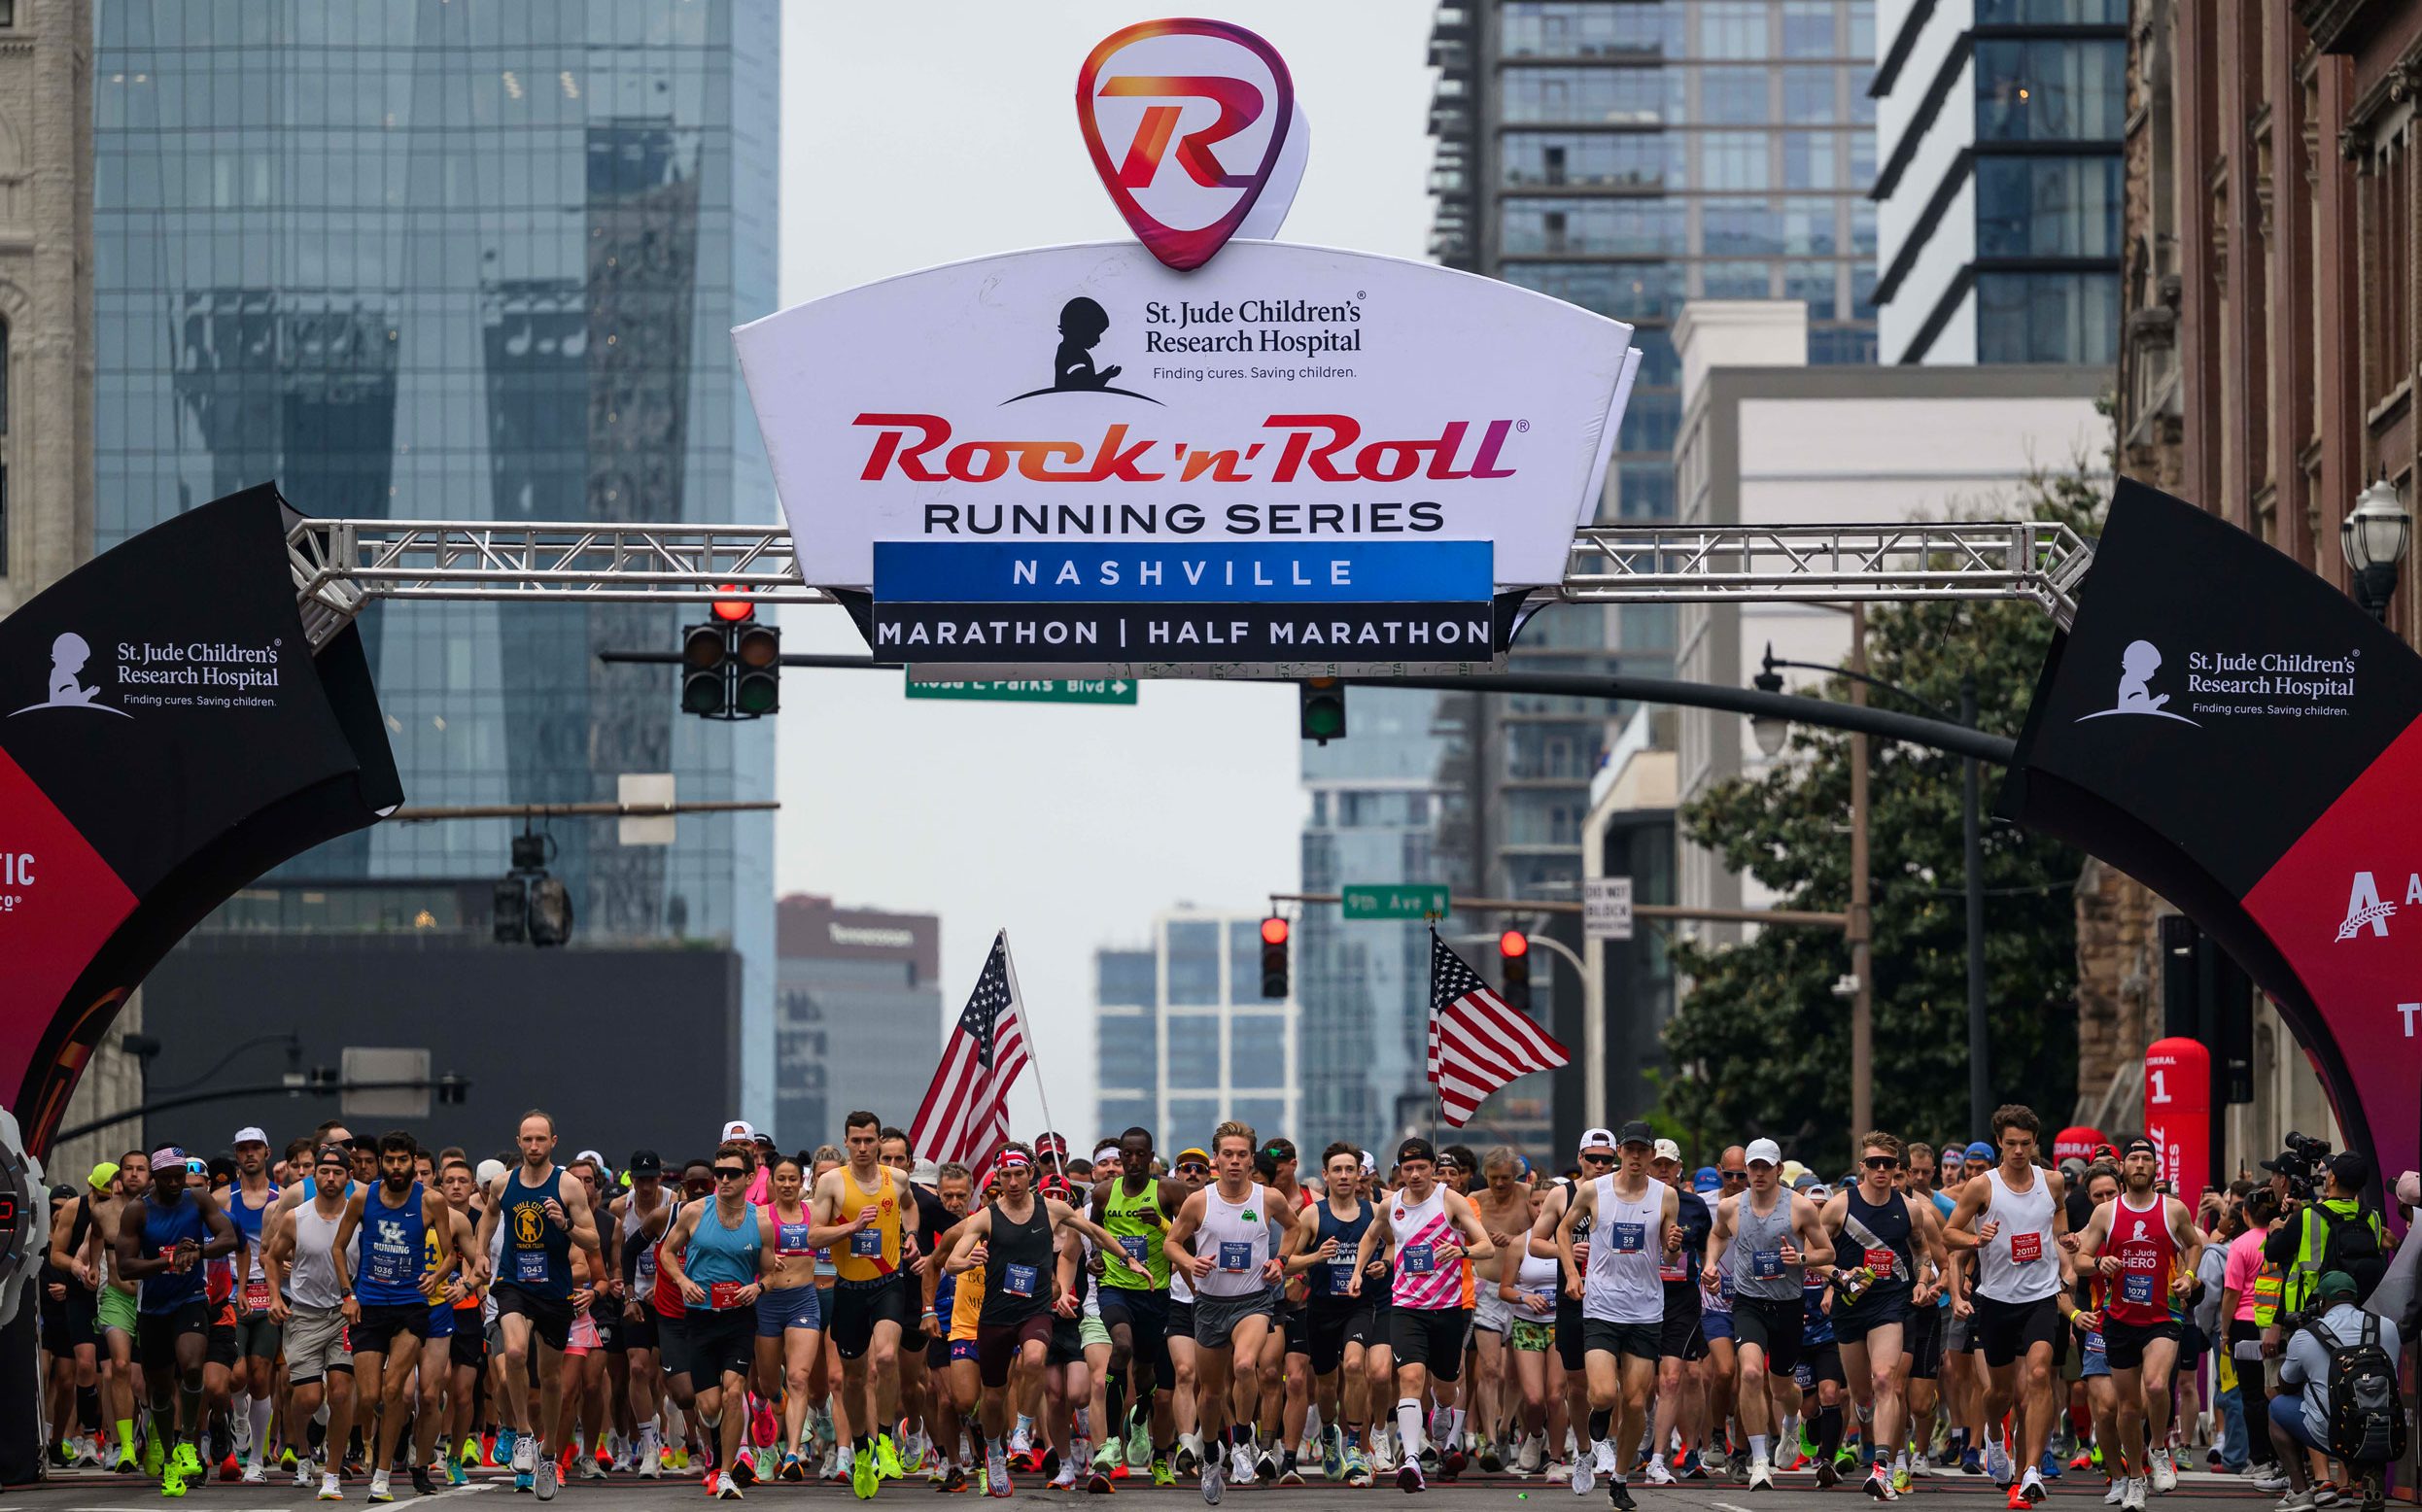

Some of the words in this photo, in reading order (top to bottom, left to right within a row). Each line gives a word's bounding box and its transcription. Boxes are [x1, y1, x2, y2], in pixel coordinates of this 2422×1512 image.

[1146, 301, 1176, 324] St.
[1179, 301, 1233, 329] Jude
[1239, 299, 1361, 324] Children’s
[1145, 328, 1254, 353] Research
[1259, 328, 1362, 358] Hospital
[1154, 367, 1203, 382] Finding
[1207, 368, 1248, 379] cures.
[1251, 366, 1296, 381] Saving
[1298, 366, 1357, 379] children.
[851, 413, 1165, 483] Rock
[1262, 413, 1517, 483] Roll
[924, 503, 1205, 535] RUNNING
[1225, 501, 1444, 534] SERIES
[1014, 560, 1353, 586] NASHVILLE
[879, 621, 1099, 645] MARATHON
[1149, 620, 1250, 644] HALF
[1270, 621, 1490, 645] MARATHON
[118, 642, 141, 661] St.
[143, 642, 184, 666] Jude
[2189, 651, 2213, 670] St.
[2214, 652, 2257, 674] Jude
[118, 665, 199, 684] Research
[202, 667, 279, 691] Hospital
[1067, 680, 1105, 694] Blvd
[2188, 674, 2270, 694] Research
[2274, 676, 2355, 701] Hospital
[123, 694, 162, 706] Finding
[164, 696, 194, 705] cures.
[196, 695, 230, 707] Saving
[232, 696, 277, 706] children.
[2193, 703, 2232, 715] Finding
[2233, 704, 2265, 714] cures.
[2267, 704, 2301, 717] Saving
[2304, 705, 2350, 716] children.
[0, 853, 35, 886] IC
[1348, 893, 1378, 911] 9th
[1390, 893, 1422, 911] Ave
[2146, 1055, 2176, 1066] CORRAL
[2150, 1070, 2172, 1104] 1
[513, 1201, 530, 1214] BULL
[531, 1201, 545, 1214] CITY
[373, 1242, 410, 1254] RUNNING
[2016, 1247, 2038, 1256] 20117
[2135, 1249, 2157, 1257] Jude
[373, 1265, 393, 1275] 1036
[2122, 1257, 2157, 1269] HERO
[248, 1295, 270, 1304] 20221
[2128, 1287, 2147, 1296] 1078
